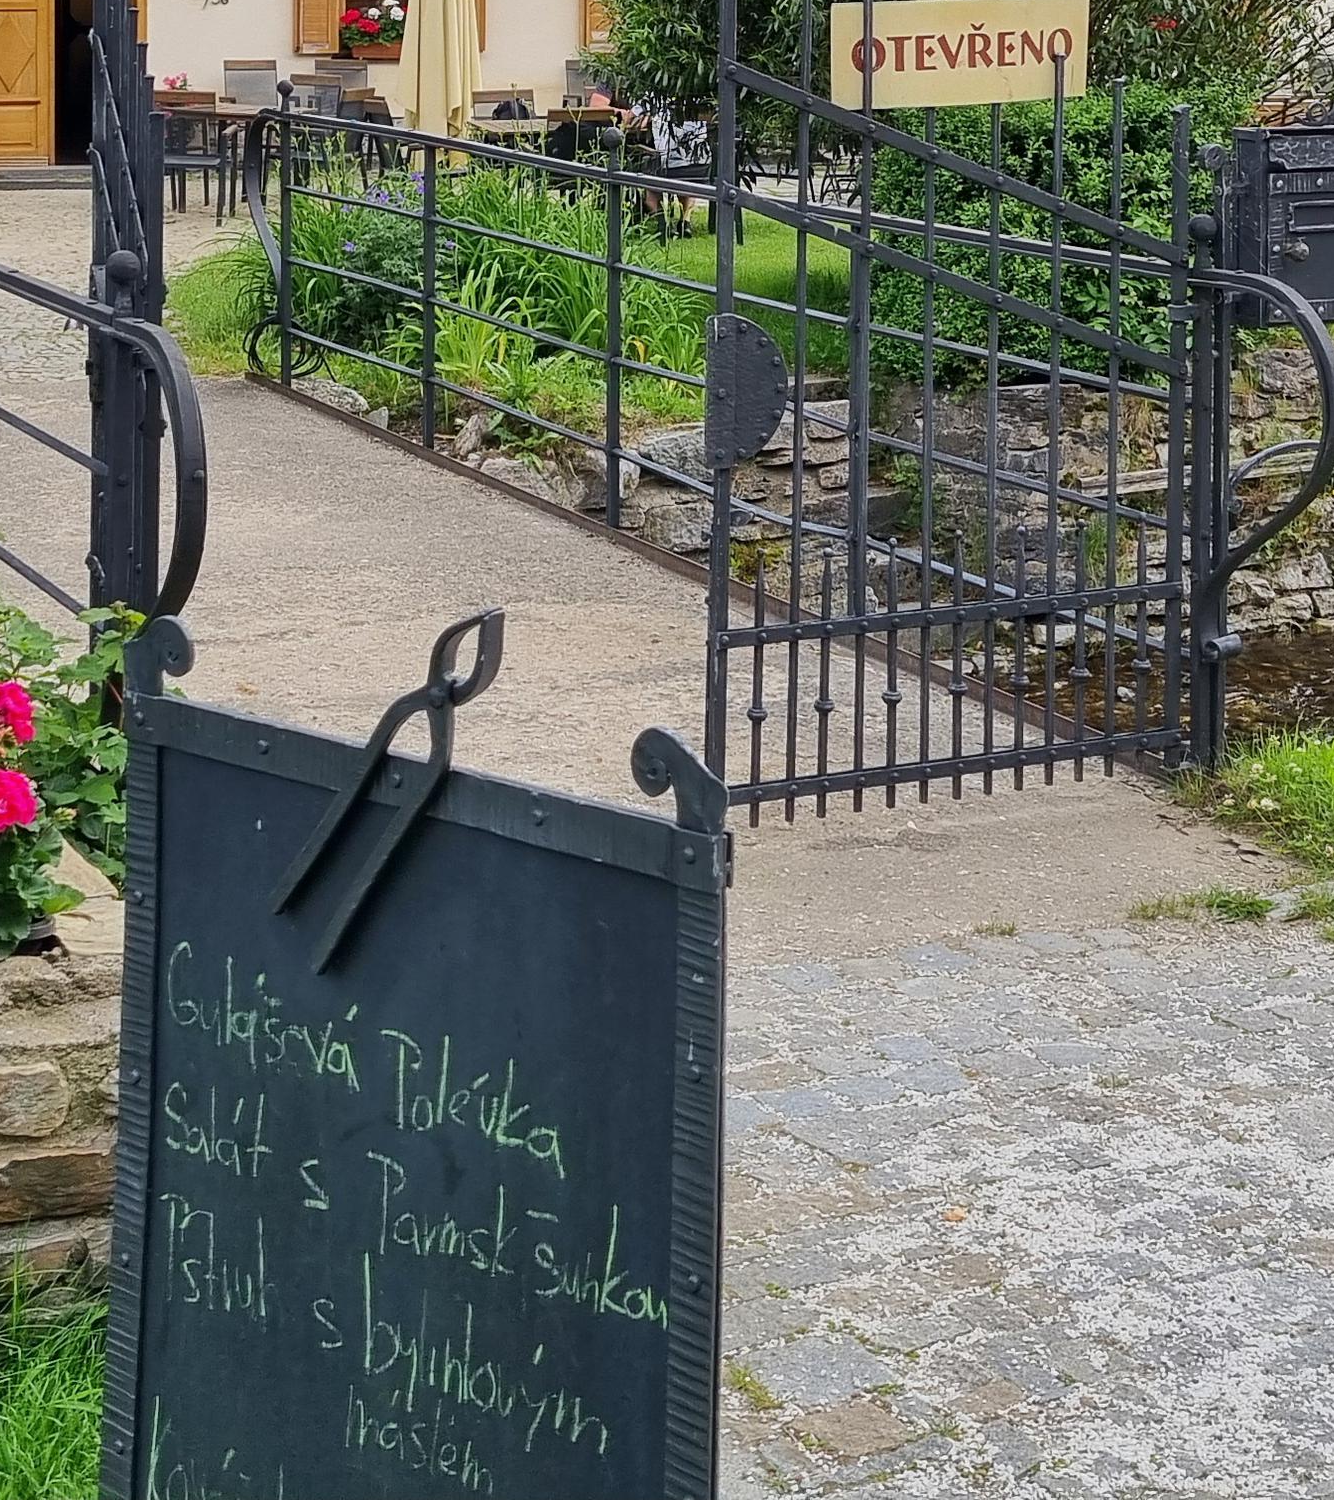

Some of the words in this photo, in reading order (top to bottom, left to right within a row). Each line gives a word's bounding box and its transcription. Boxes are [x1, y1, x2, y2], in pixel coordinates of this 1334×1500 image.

[851, 22, 1073, 74] OTEVŘENO
[164, 1080, 273, 1178] Salát
[380, 1027, 566, 1180] Polévka
